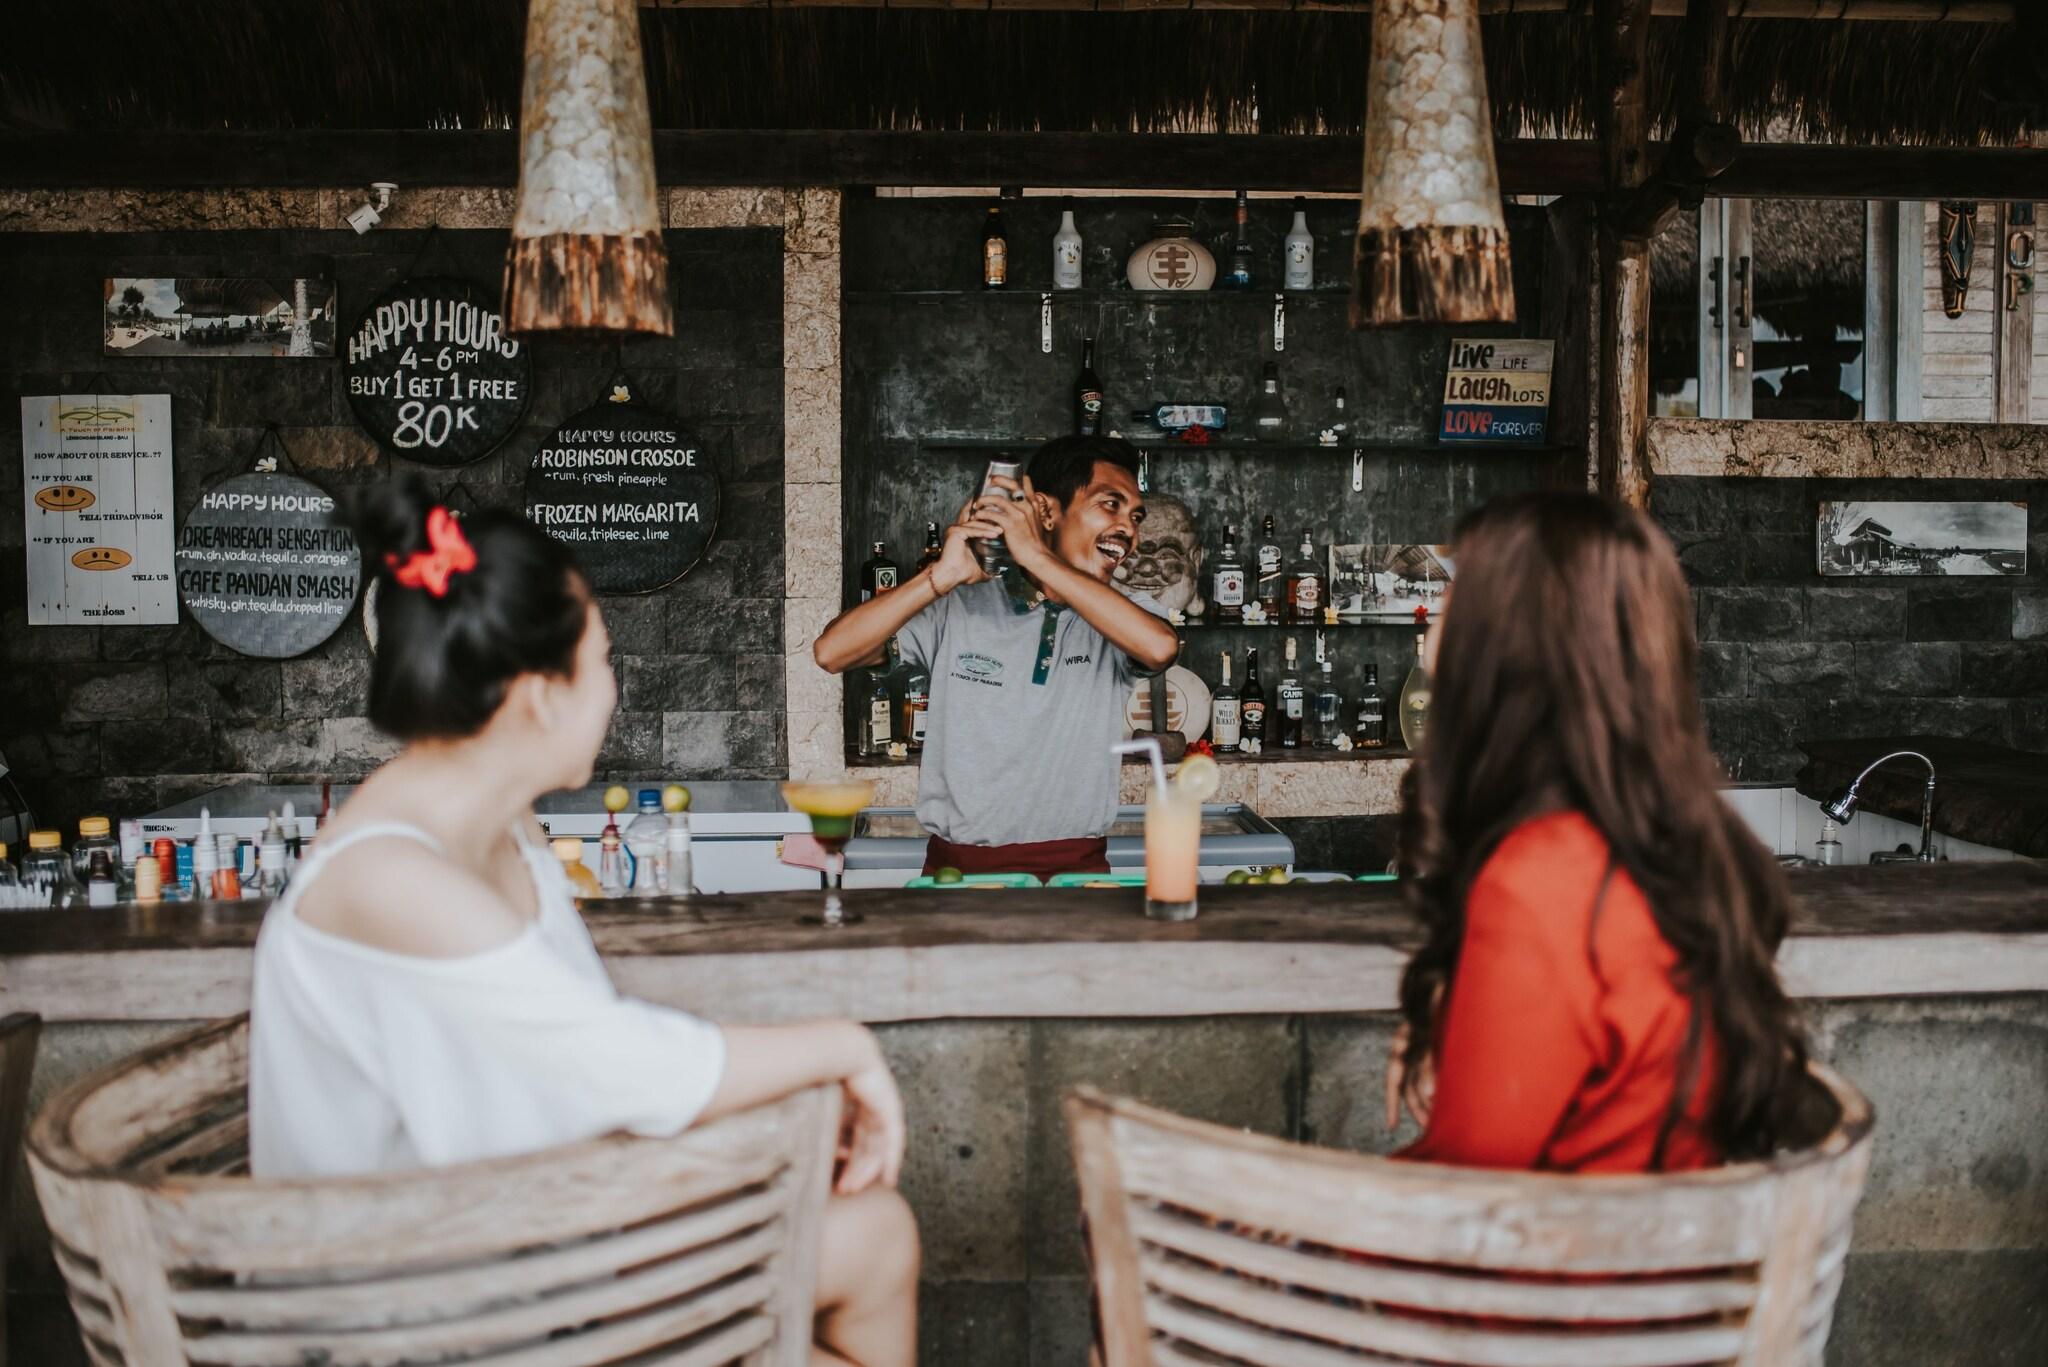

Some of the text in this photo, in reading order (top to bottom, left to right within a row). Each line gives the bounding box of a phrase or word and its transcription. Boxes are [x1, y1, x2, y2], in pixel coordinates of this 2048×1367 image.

[349, 298, 429, 364] HAPPY
[456, 351, 479, 364] PM
[1502, 358, 1529, 370] LIFE
[351, 369, 518, 400] BUY 1 GET 1 FREE
[1447, 376, 1545, 403] Laugh LOTS
[1491, 421, 1544, 435] FOREVER
[558, 429, 677, 444] HAPPY HOURS
[34, 452, 55, 460] HOW
[57, 452, 89, 460] ABOUT
[89, 451, 110, 460] OUR
[541, 448, 697, 468] ROBINSON CROSOE
[74, 474, 93, 482] ARE
[583, 471, 615, 486] fresh
[618, 472, 668, 487] pineapple
[202, 492, 335, 513] HAPPY HOURS
[103, 513, 164, 521] TRIPADVISOR
[534, 502, 699, 525] FROZEN MARGARITA
[76, 536, 95, 544] ARE
[182, 526, 354, 552] DREAMBEACH SENSATION
[181, 569, 354, 600] CAFE PANDAN SMASH
[102, 608, 126, 616] BOSS
[1065, 655, 1091, 666] WIRA
